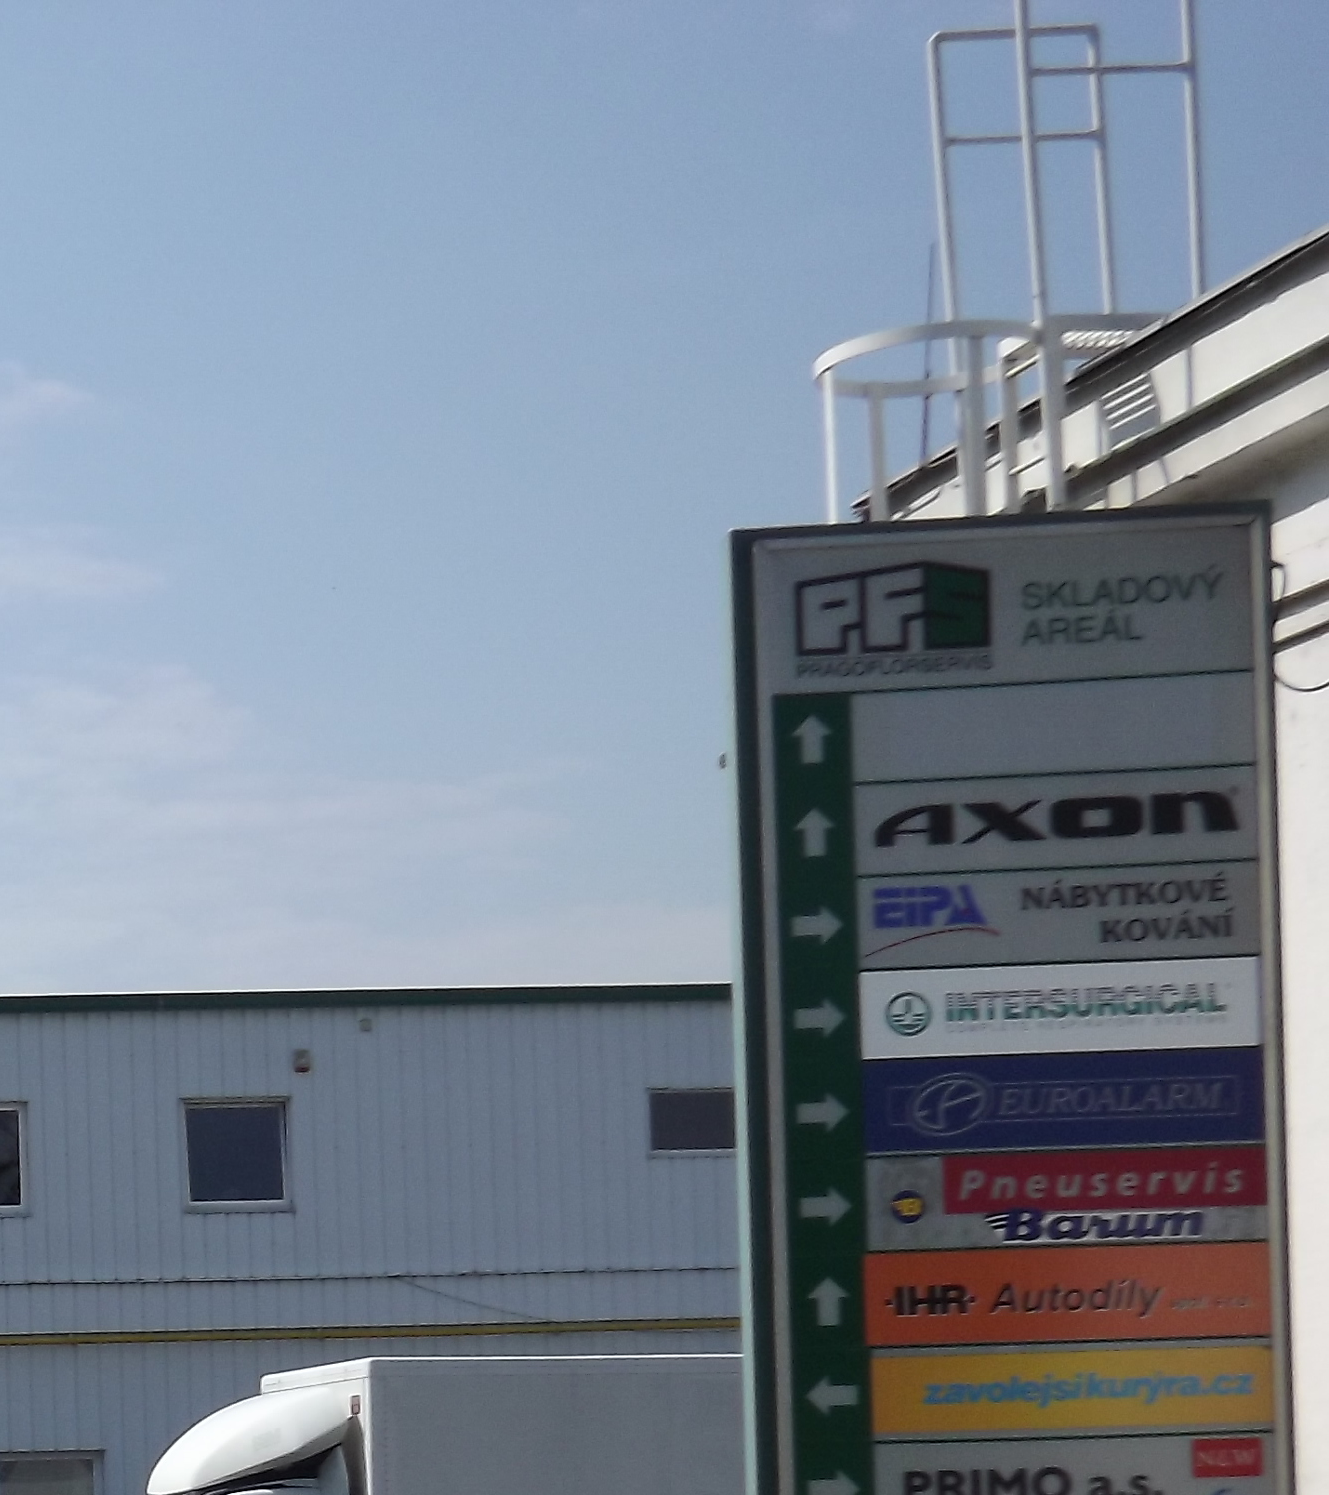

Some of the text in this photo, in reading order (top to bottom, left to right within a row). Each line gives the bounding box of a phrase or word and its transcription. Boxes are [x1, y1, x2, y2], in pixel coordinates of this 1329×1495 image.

[1021, 565, 1224, 611] SKLADOVÝ
[1021, 612, 1146, 647] AREÁL
[1021, 871, 1229, 911] NÁBYTKOVÉ
[1100, 908, 1235, 945] KOVÁNÍ
[945, 982, 1228, 1022] INTERSURGICAL
[997, 1082, 1224, 1115] EUROALARM
[959, 1162, 1244, 1199] Pneuservis
[985, 1208, 1204, 1243] Barum
[989, 1279, 1163, 1318] Autodíly
